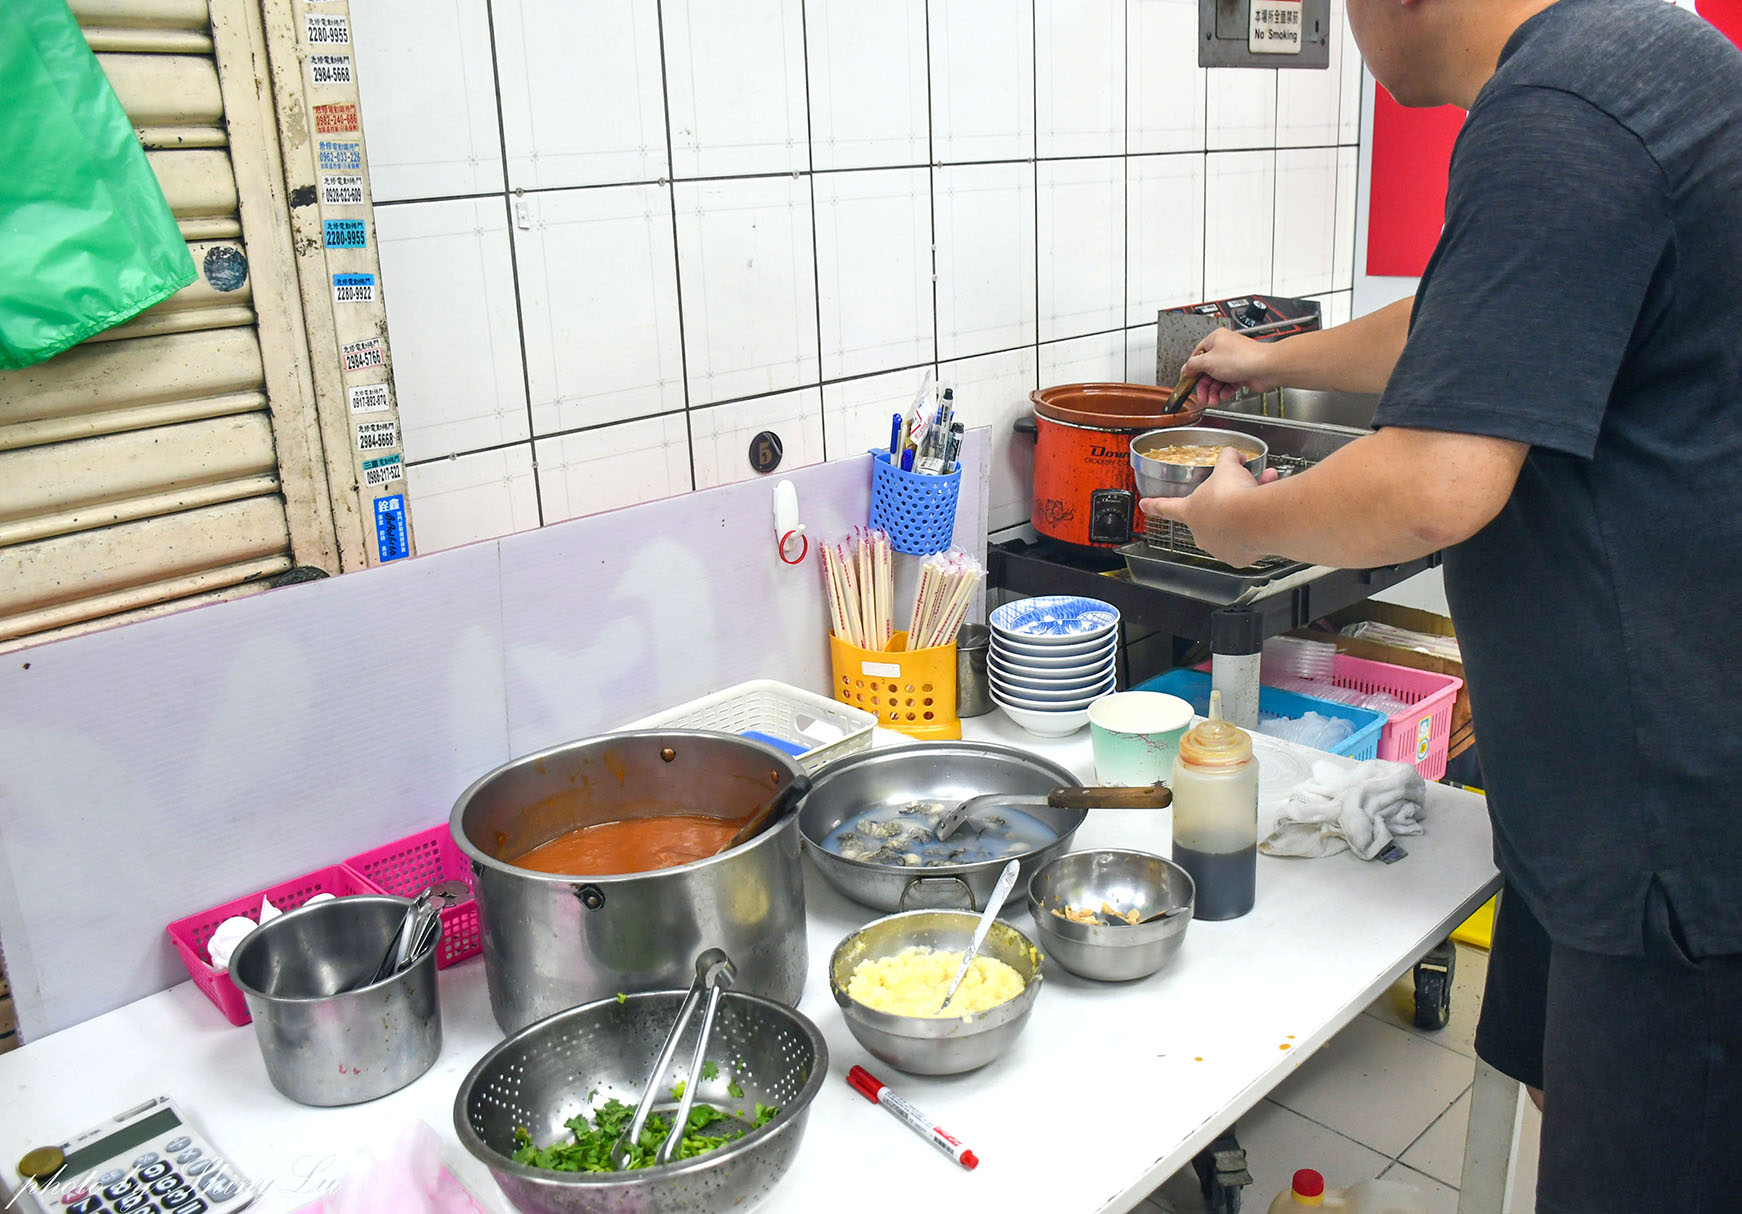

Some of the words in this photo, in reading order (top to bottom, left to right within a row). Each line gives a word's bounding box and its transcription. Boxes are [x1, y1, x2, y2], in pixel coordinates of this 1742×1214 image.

[308, 27, 349, 42] 2280-9955
[1255, 29, 1264, 39] No
[1268, 29, 1298, 43] Smoking
[313, 67, 350, 81] 2984-5668
[326, 231, 365, 245] 2280-9955
[337, 287, 371, 300] 2280-9922
[346, 350, 381, 369] 2984-5766
[360, 432, 394, 448] 2984-5668
[760, 441, 773, 464] 5
